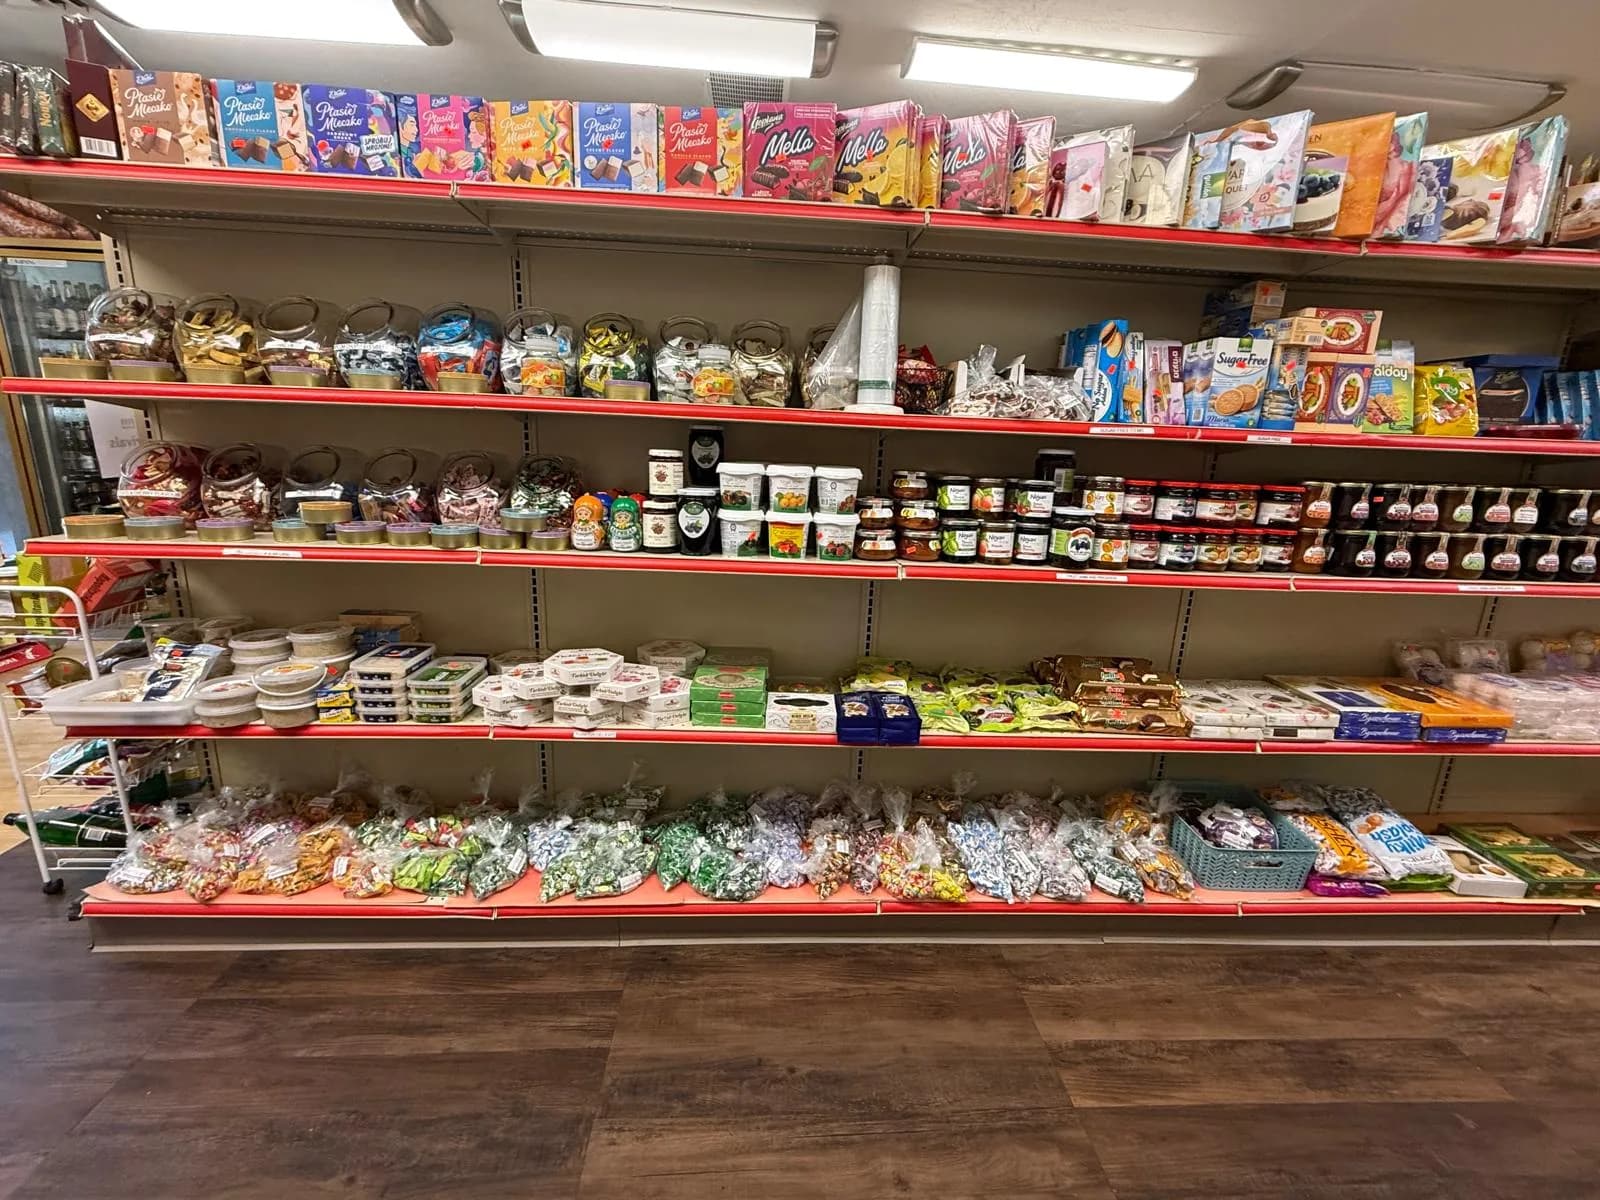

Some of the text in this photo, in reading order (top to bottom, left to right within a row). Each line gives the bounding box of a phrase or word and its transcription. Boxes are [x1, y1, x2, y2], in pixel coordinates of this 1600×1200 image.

[125, 87, 166, 107] Ptasie
[224, 96, 265, 116] Ptasie
[316, 101, 357, 121] Ptasie
[584, 117, 622, 136] Ptasie
[669, 122, 708, 141] Ptasie
[761, 127, 814, 165] Mella
[838, 129, 887, 172] Mella
[1217, 352, 1247, 368] Sugar
[1247, 353, 1268, 366] Free
[1374, 365, 1408, 381] alday
[1383, 836, 1432, 855] Milky
